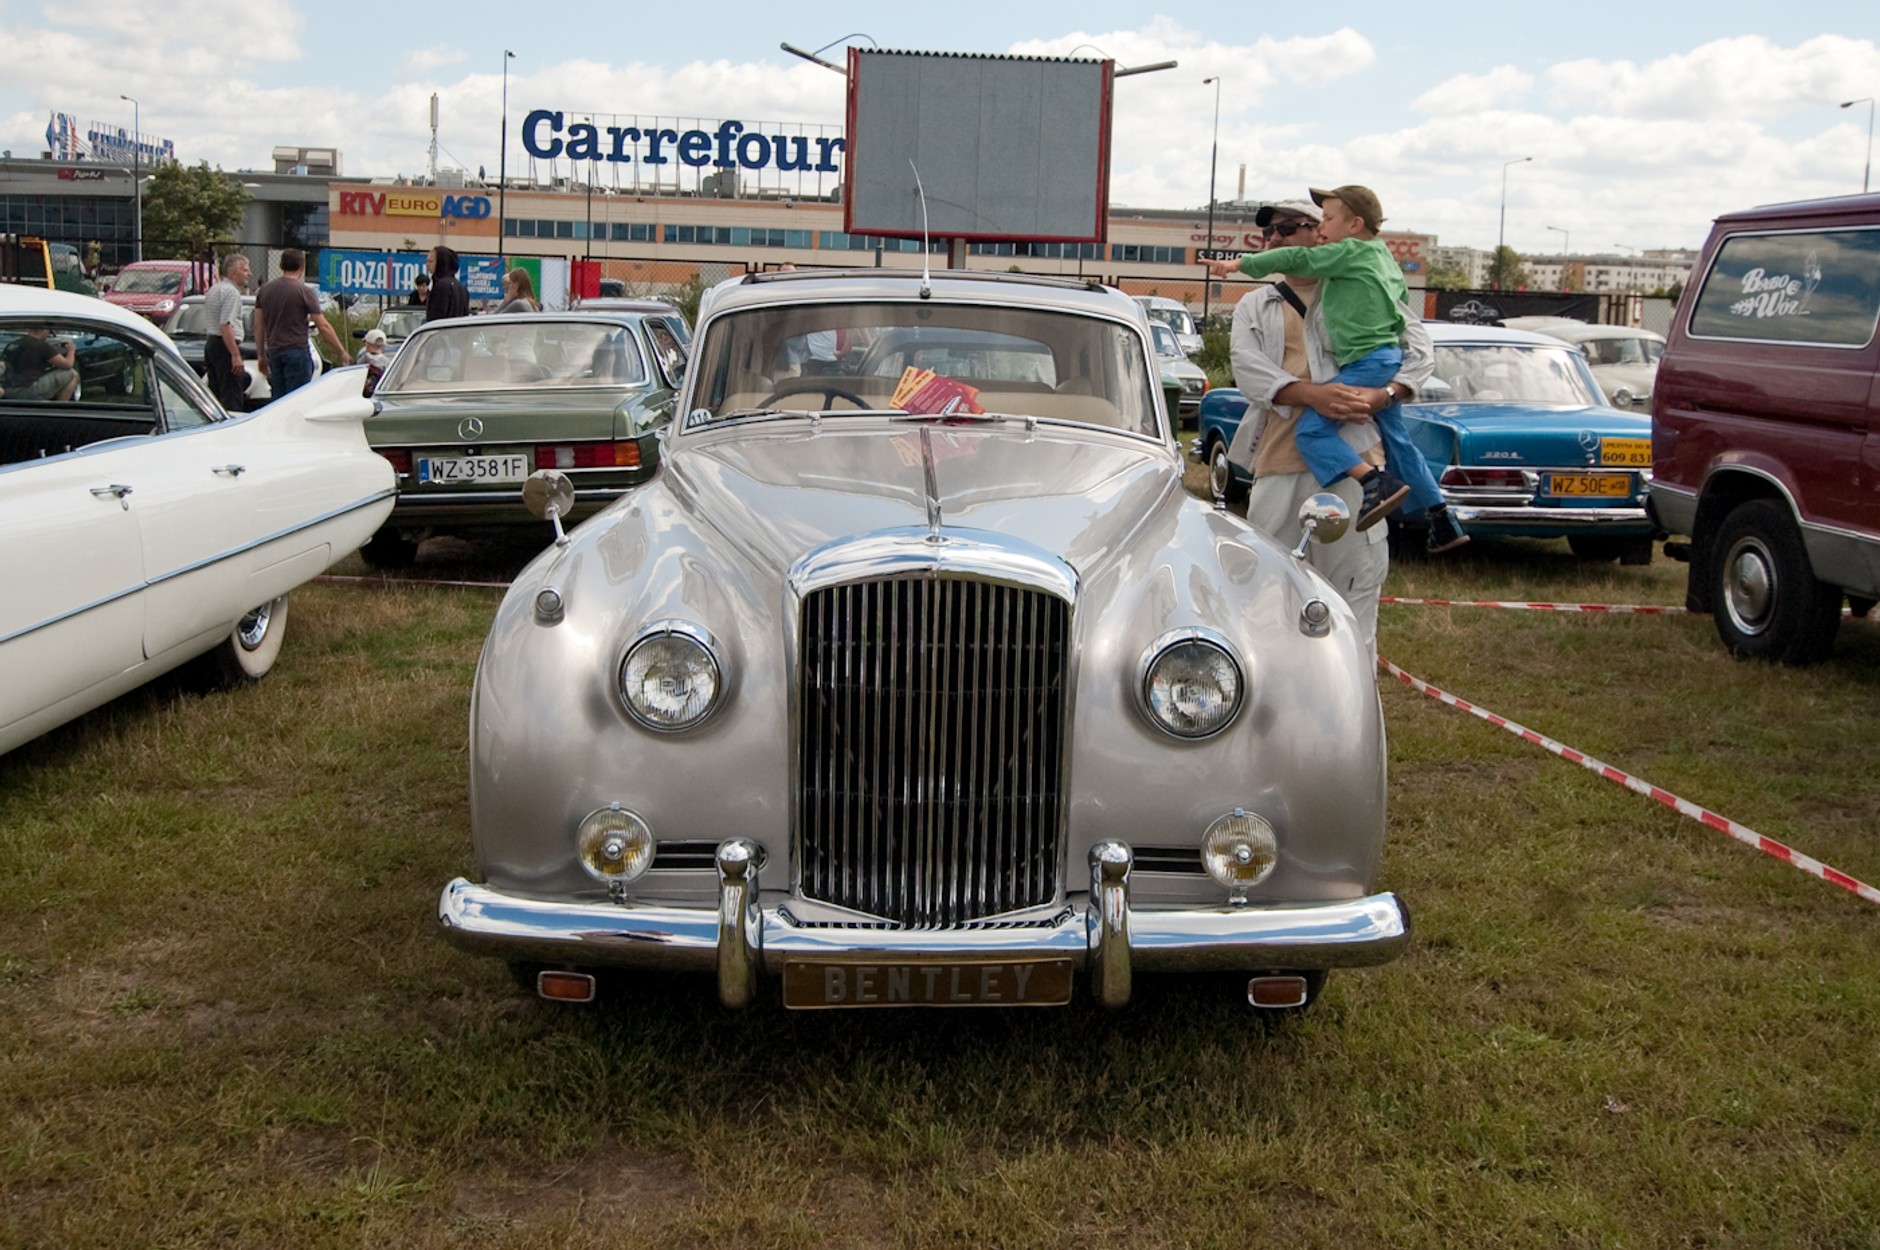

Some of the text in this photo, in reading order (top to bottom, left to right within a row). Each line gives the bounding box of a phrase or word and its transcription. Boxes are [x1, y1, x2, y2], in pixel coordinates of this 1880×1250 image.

[522, 109, 845, 172] Carrefour
[340, 191, 492, 219] RTV EURO AGD
[432, 459, 522, 478] WZ 3581F
[1603, 453, 1626, 462] 609
[1552, 477, 1608, 493] WZ 50E
[824, 965, 1034, 1002] BENTLEY
